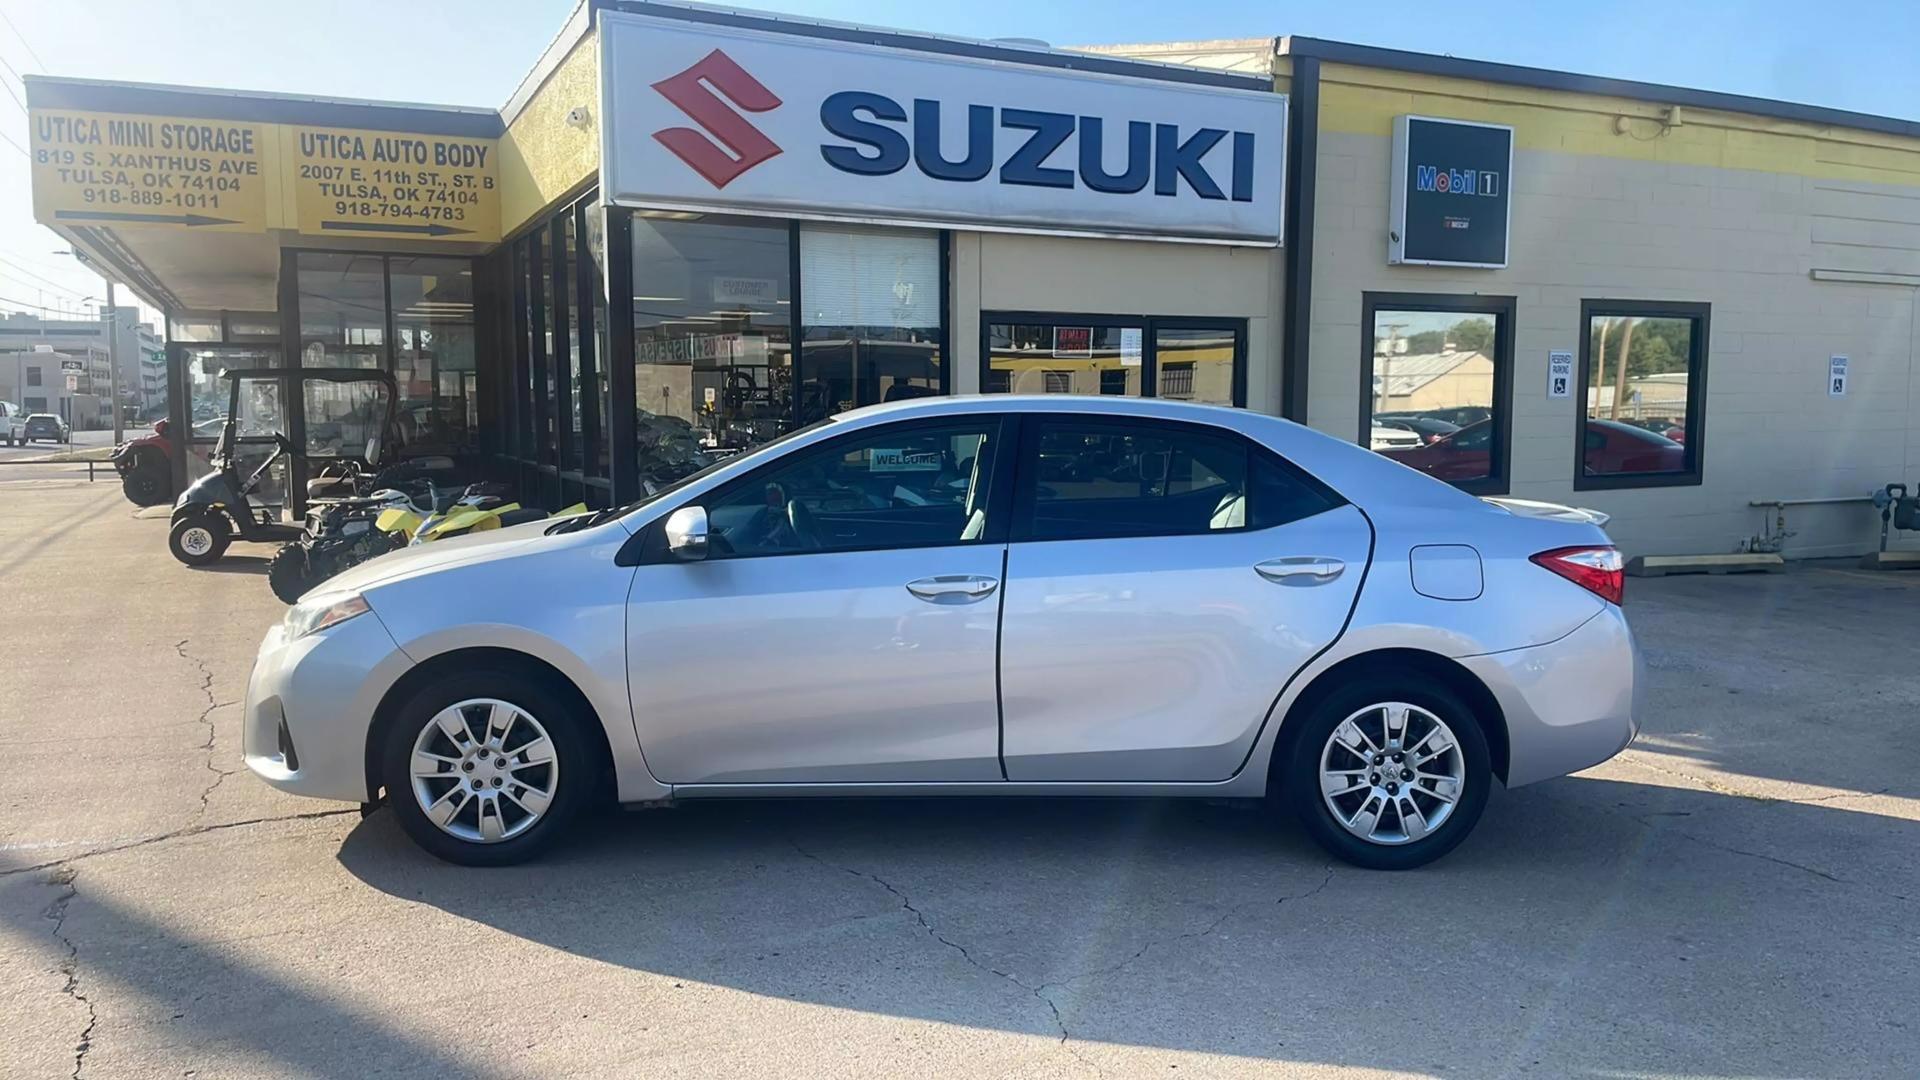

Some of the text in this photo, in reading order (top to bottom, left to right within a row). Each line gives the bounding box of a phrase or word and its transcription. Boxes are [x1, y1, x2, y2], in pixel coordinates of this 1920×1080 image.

[38, 116, 254, 155] UTICA MINI STORAGE
[820, 90, 1254, 203] SUZUKI
[301, 132, 488, 168] UTICA AUTO BODY
[38, 149, 258, 176] 819 S. XANTHUS AVE
[57, 168, 241, 192] TULSA, OK 74104
[300, 165, 494, 189] 2007 E. 11th ST., ST. B
[1417, 165, 1476, 195] Mobil
[83, 188, 219, 209] 918-889-1011
[318, 183, 478, 205] TULSA, OK 74104
[336, 201, 465, 221] 918-794-4783
[876, 454, 937, 465] WELCOME
